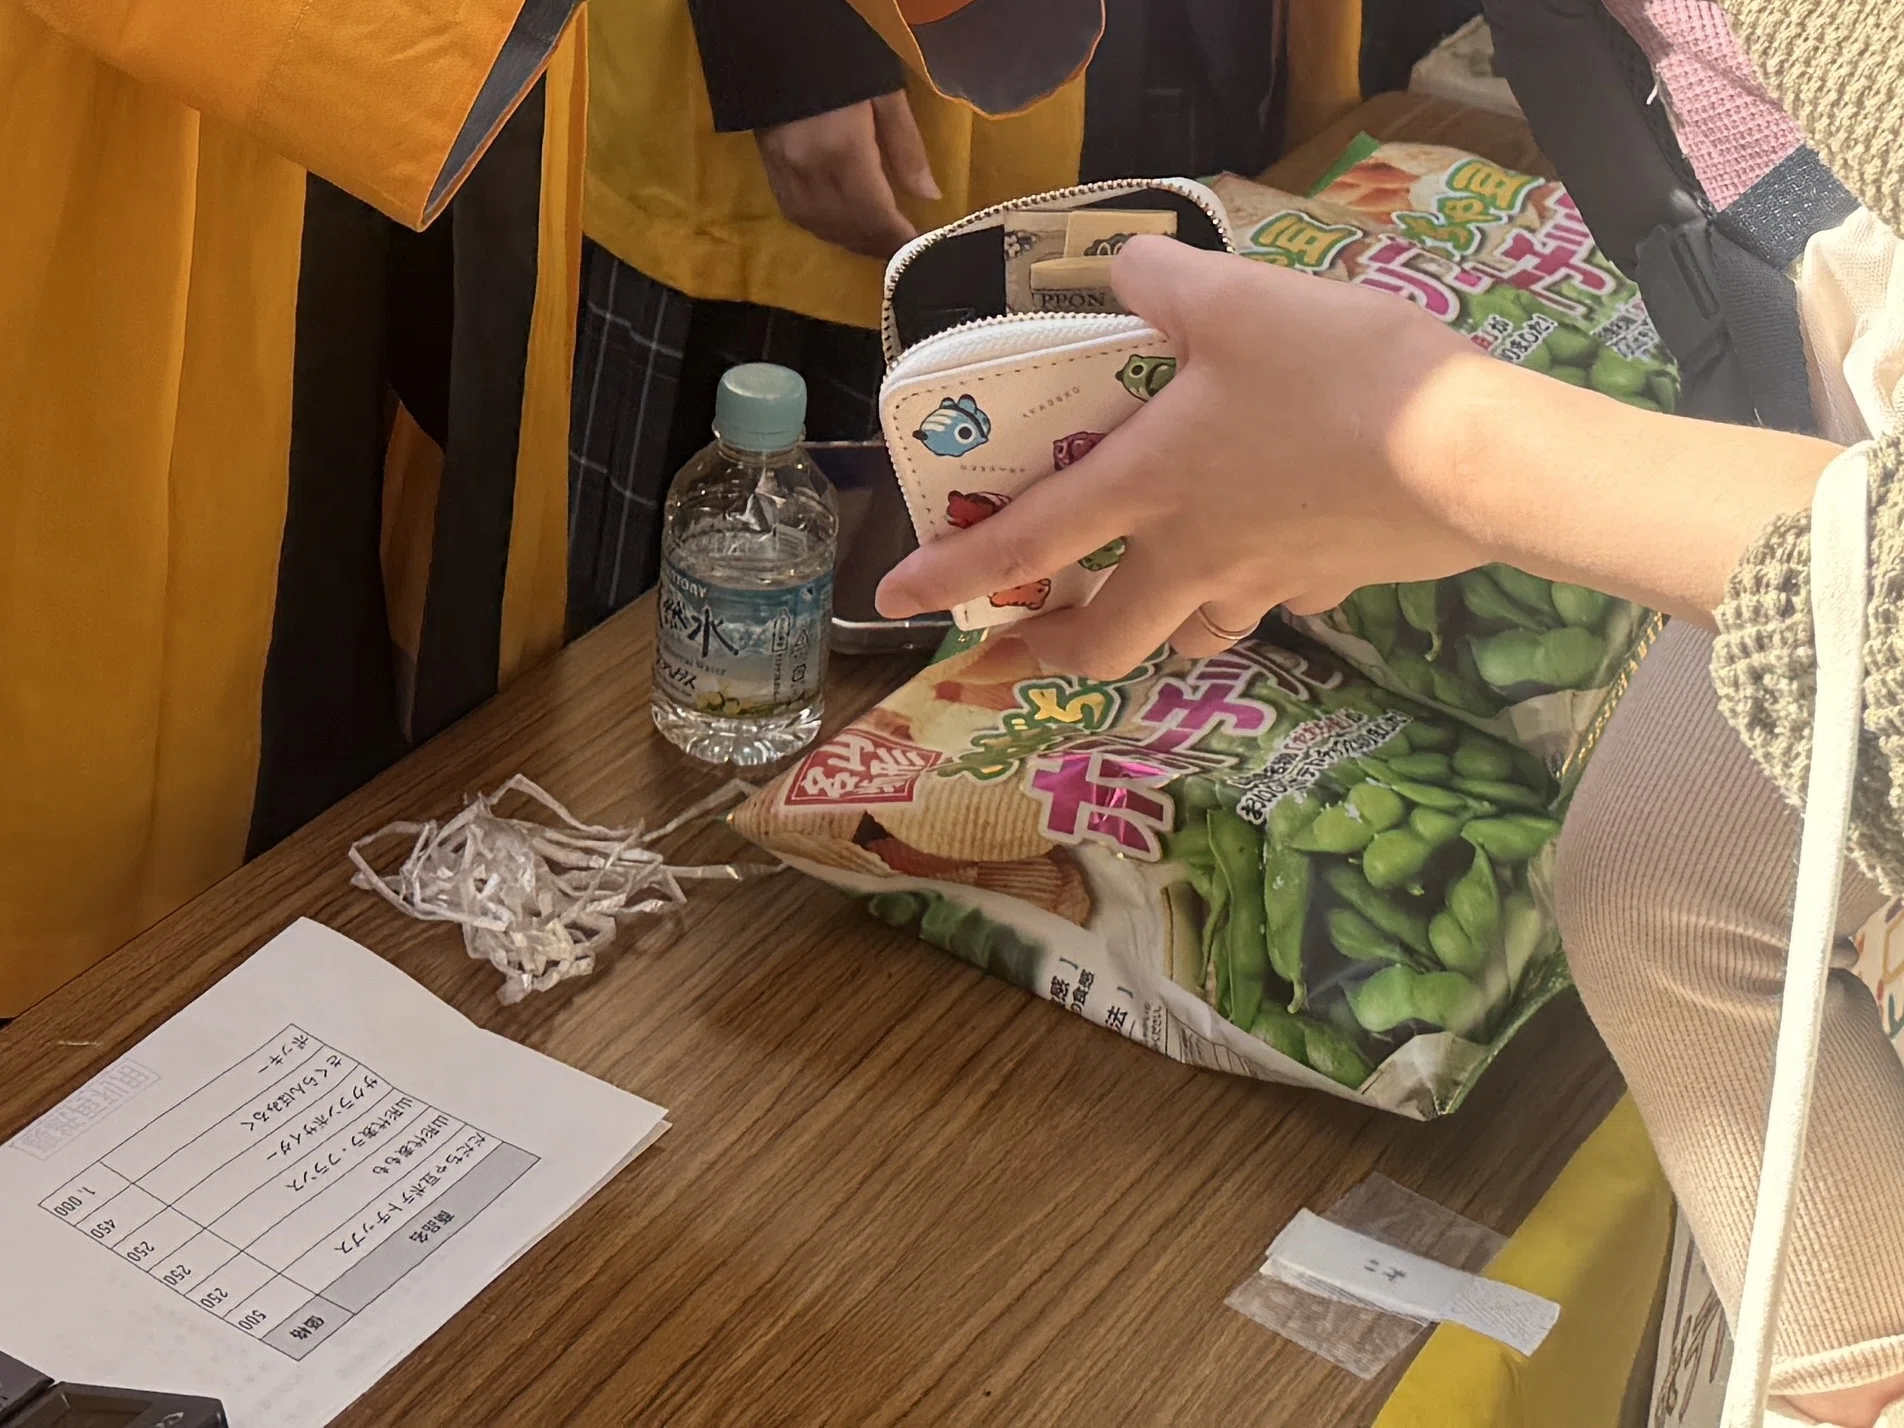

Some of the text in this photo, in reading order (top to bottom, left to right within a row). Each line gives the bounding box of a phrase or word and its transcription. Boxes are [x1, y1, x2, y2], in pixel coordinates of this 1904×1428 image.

[240, 1055, 344, 1132] さくらんぼみるく
[264, 1074, 380, 1162] サクランボサイダー
[284, 1095, 414, 1193] 山形代表ラ・フランス
[371, 1113, 450, 1176] 山形代表もも
[332, 1131, 486, 1255] だだちゃ豆ポテトチップス
[89, 1217, 118, 1240] 450
[408, 1210, 455, 1244] 商品名
[126, 1240, 156, 1263] 250
[163, 1263, 192, 1287] 250
[200, 1286, 229, 1310] 250
[237, 1309, 267, 1332] 500
[289, 1314, 326, 1342] 価格
